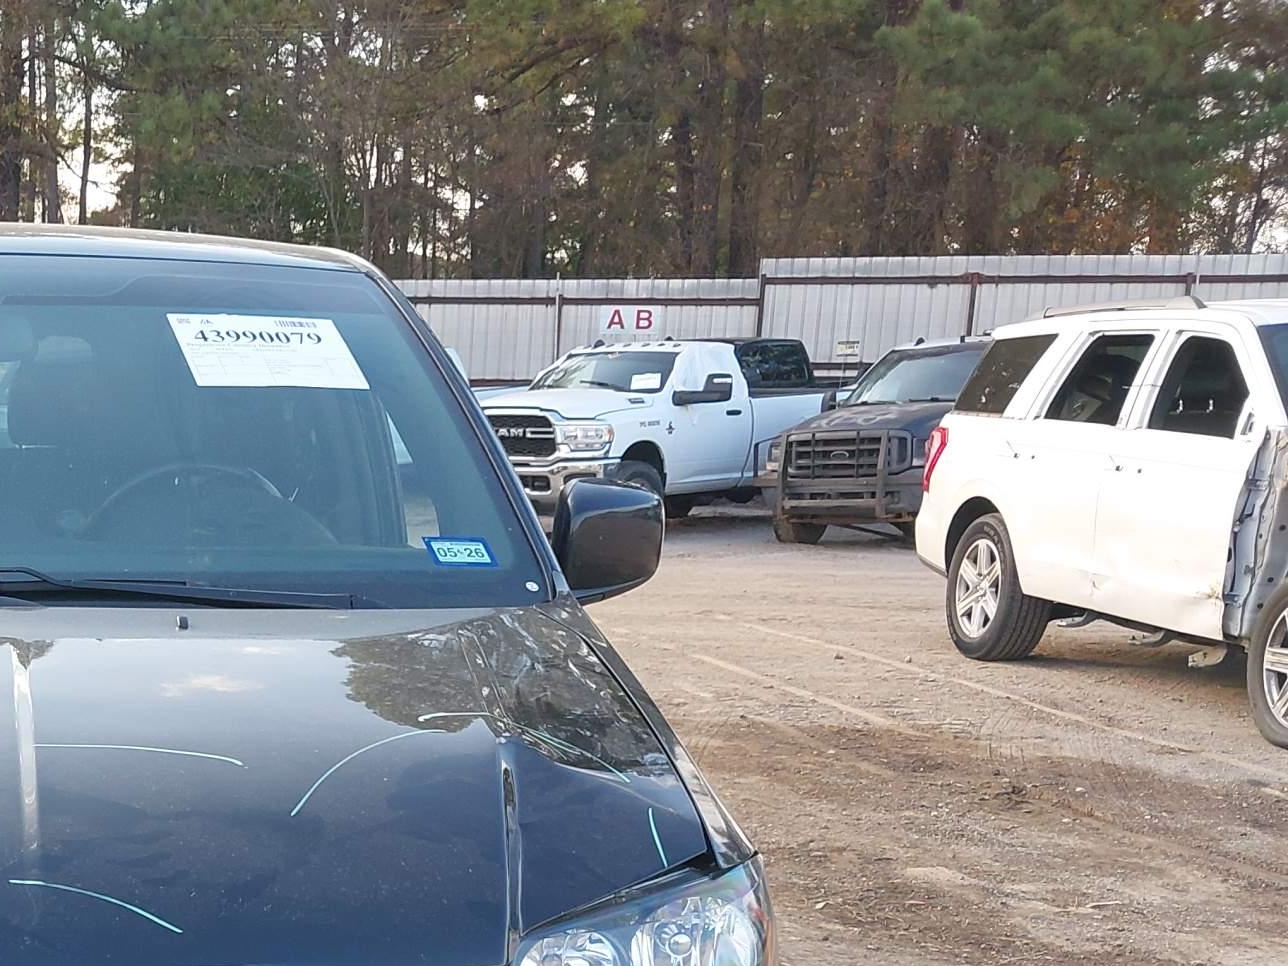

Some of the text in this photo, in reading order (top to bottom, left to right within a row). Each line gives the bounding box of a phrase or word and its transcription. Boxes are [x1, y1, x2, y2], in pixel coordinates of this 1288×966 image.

[606, 309, 653, 330] A B
[193, 328, 323, 346] 43990079
